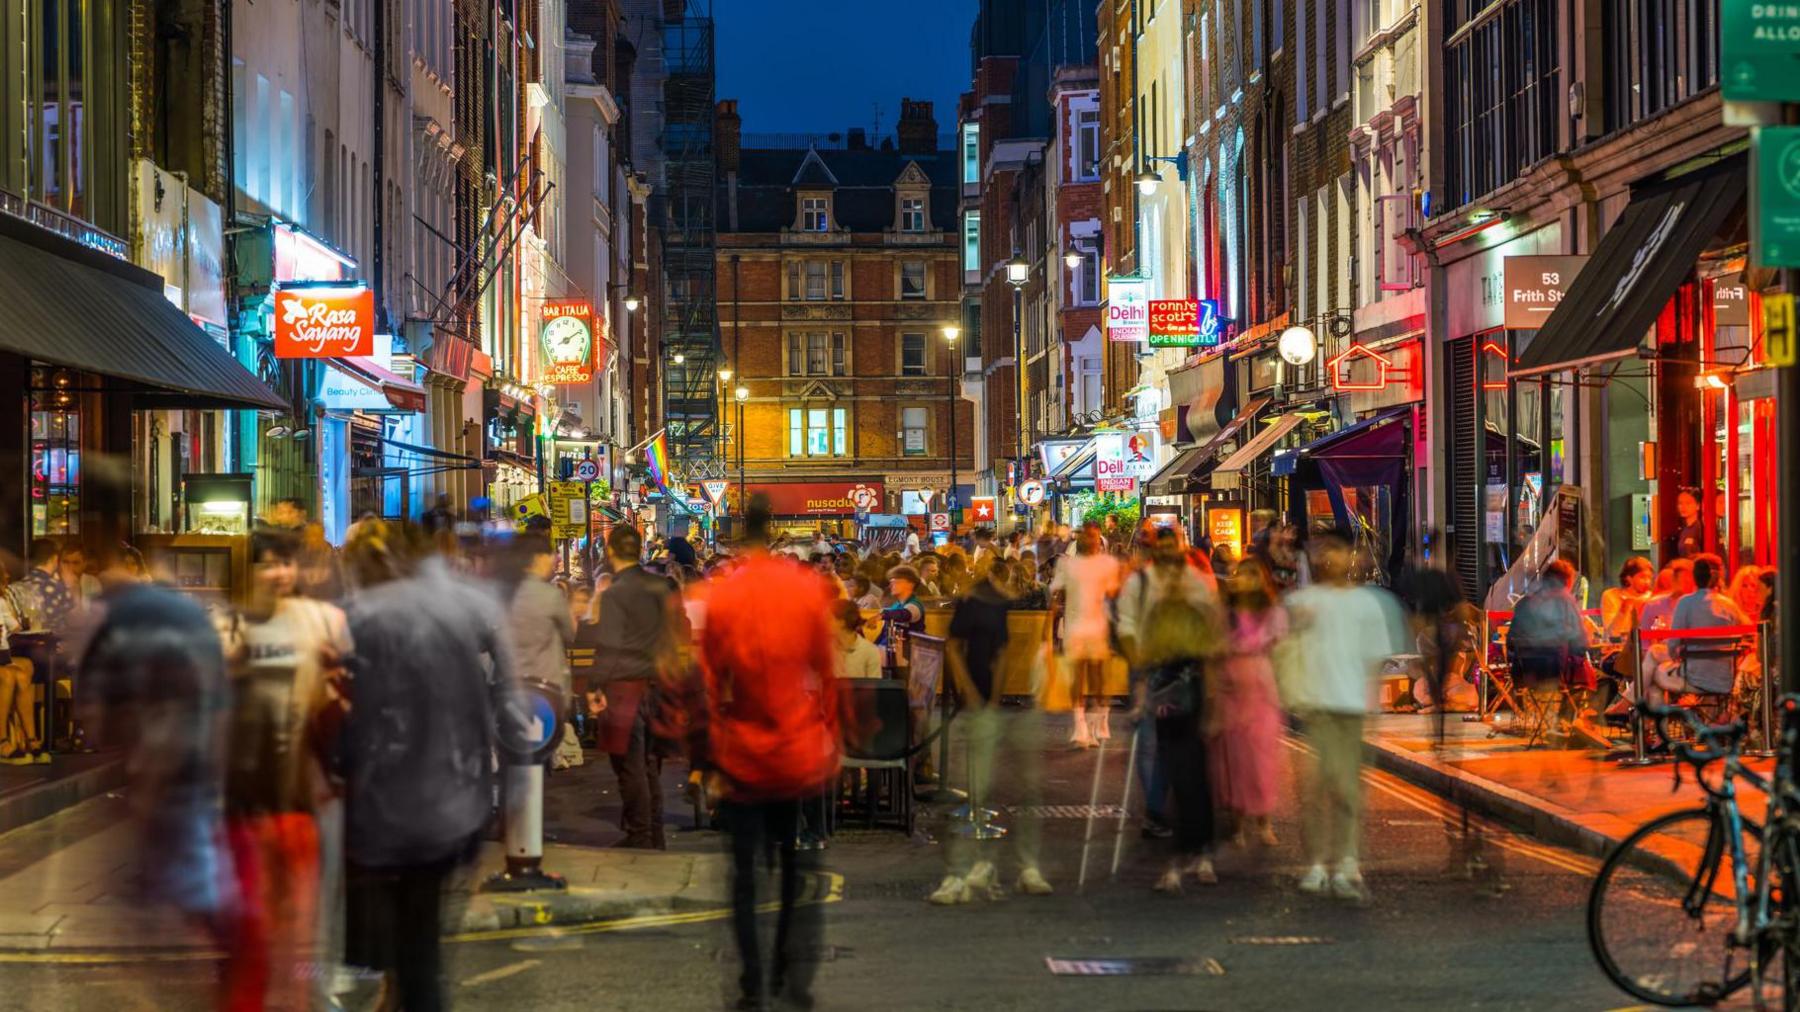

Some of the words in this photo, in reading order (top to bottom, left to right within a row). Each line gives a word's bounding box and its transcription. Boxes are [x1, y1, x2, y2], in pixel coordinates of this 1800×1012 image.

[1754, 26, 1800, 40] ALLO
[1542, 272, 1560, 285] 53
[1513, 289, 1545, 302] Frith
[543, 306, 560, 316] BAR
[562, 305, 590, 316] ITALIA
[1151, 301, 1197, 311] ronnie
[308, 302, 356, 327] Rasa
[1110, 306, 1145, 320] Delhi
[289, 320, 362, 352] Sayang
[1150, 335, 1175, 344] OPEN
[327, 387, 358, 397] Beauty
[580, 465, 595, 475] 20
